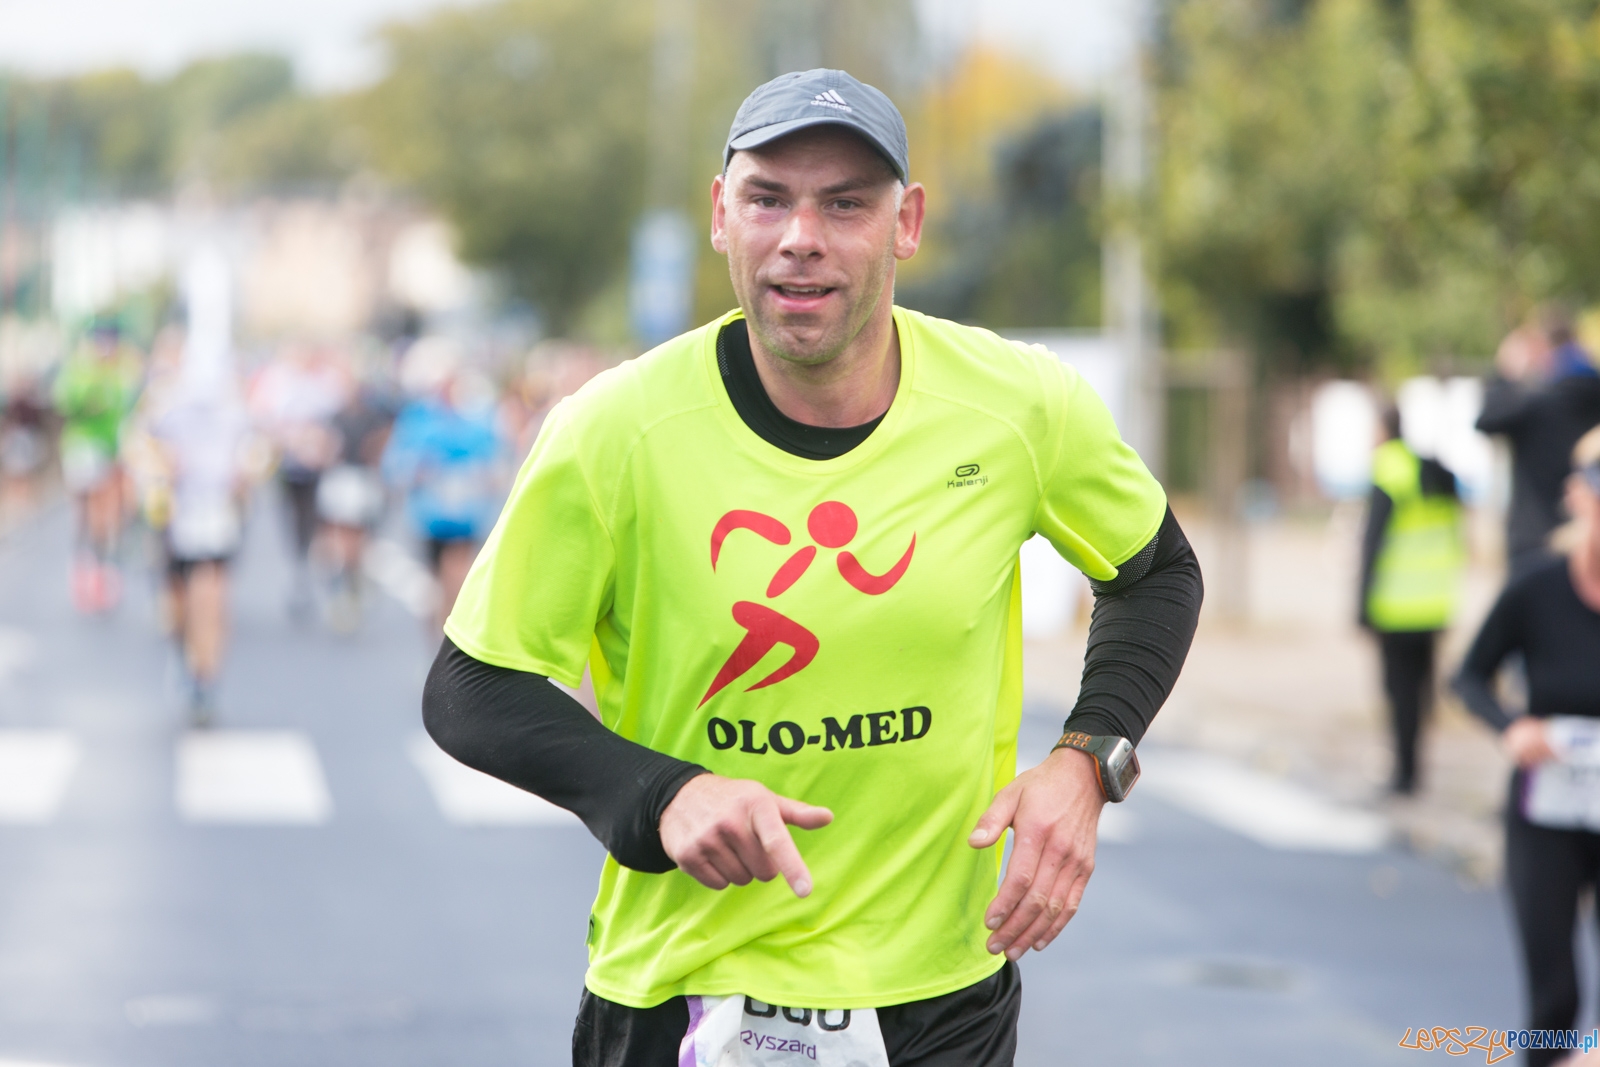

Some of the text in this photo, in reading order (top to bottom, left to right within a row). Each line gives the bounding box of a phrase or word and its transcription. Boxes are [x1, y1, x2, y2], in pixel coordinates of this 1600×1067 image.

[811, 100, 852, 113] adidas
[947, 476, 988, 488] Kalenji
[707, 705, 932, 755] OLO-MED
[740, 1029, 817, 1060] Ryszard
